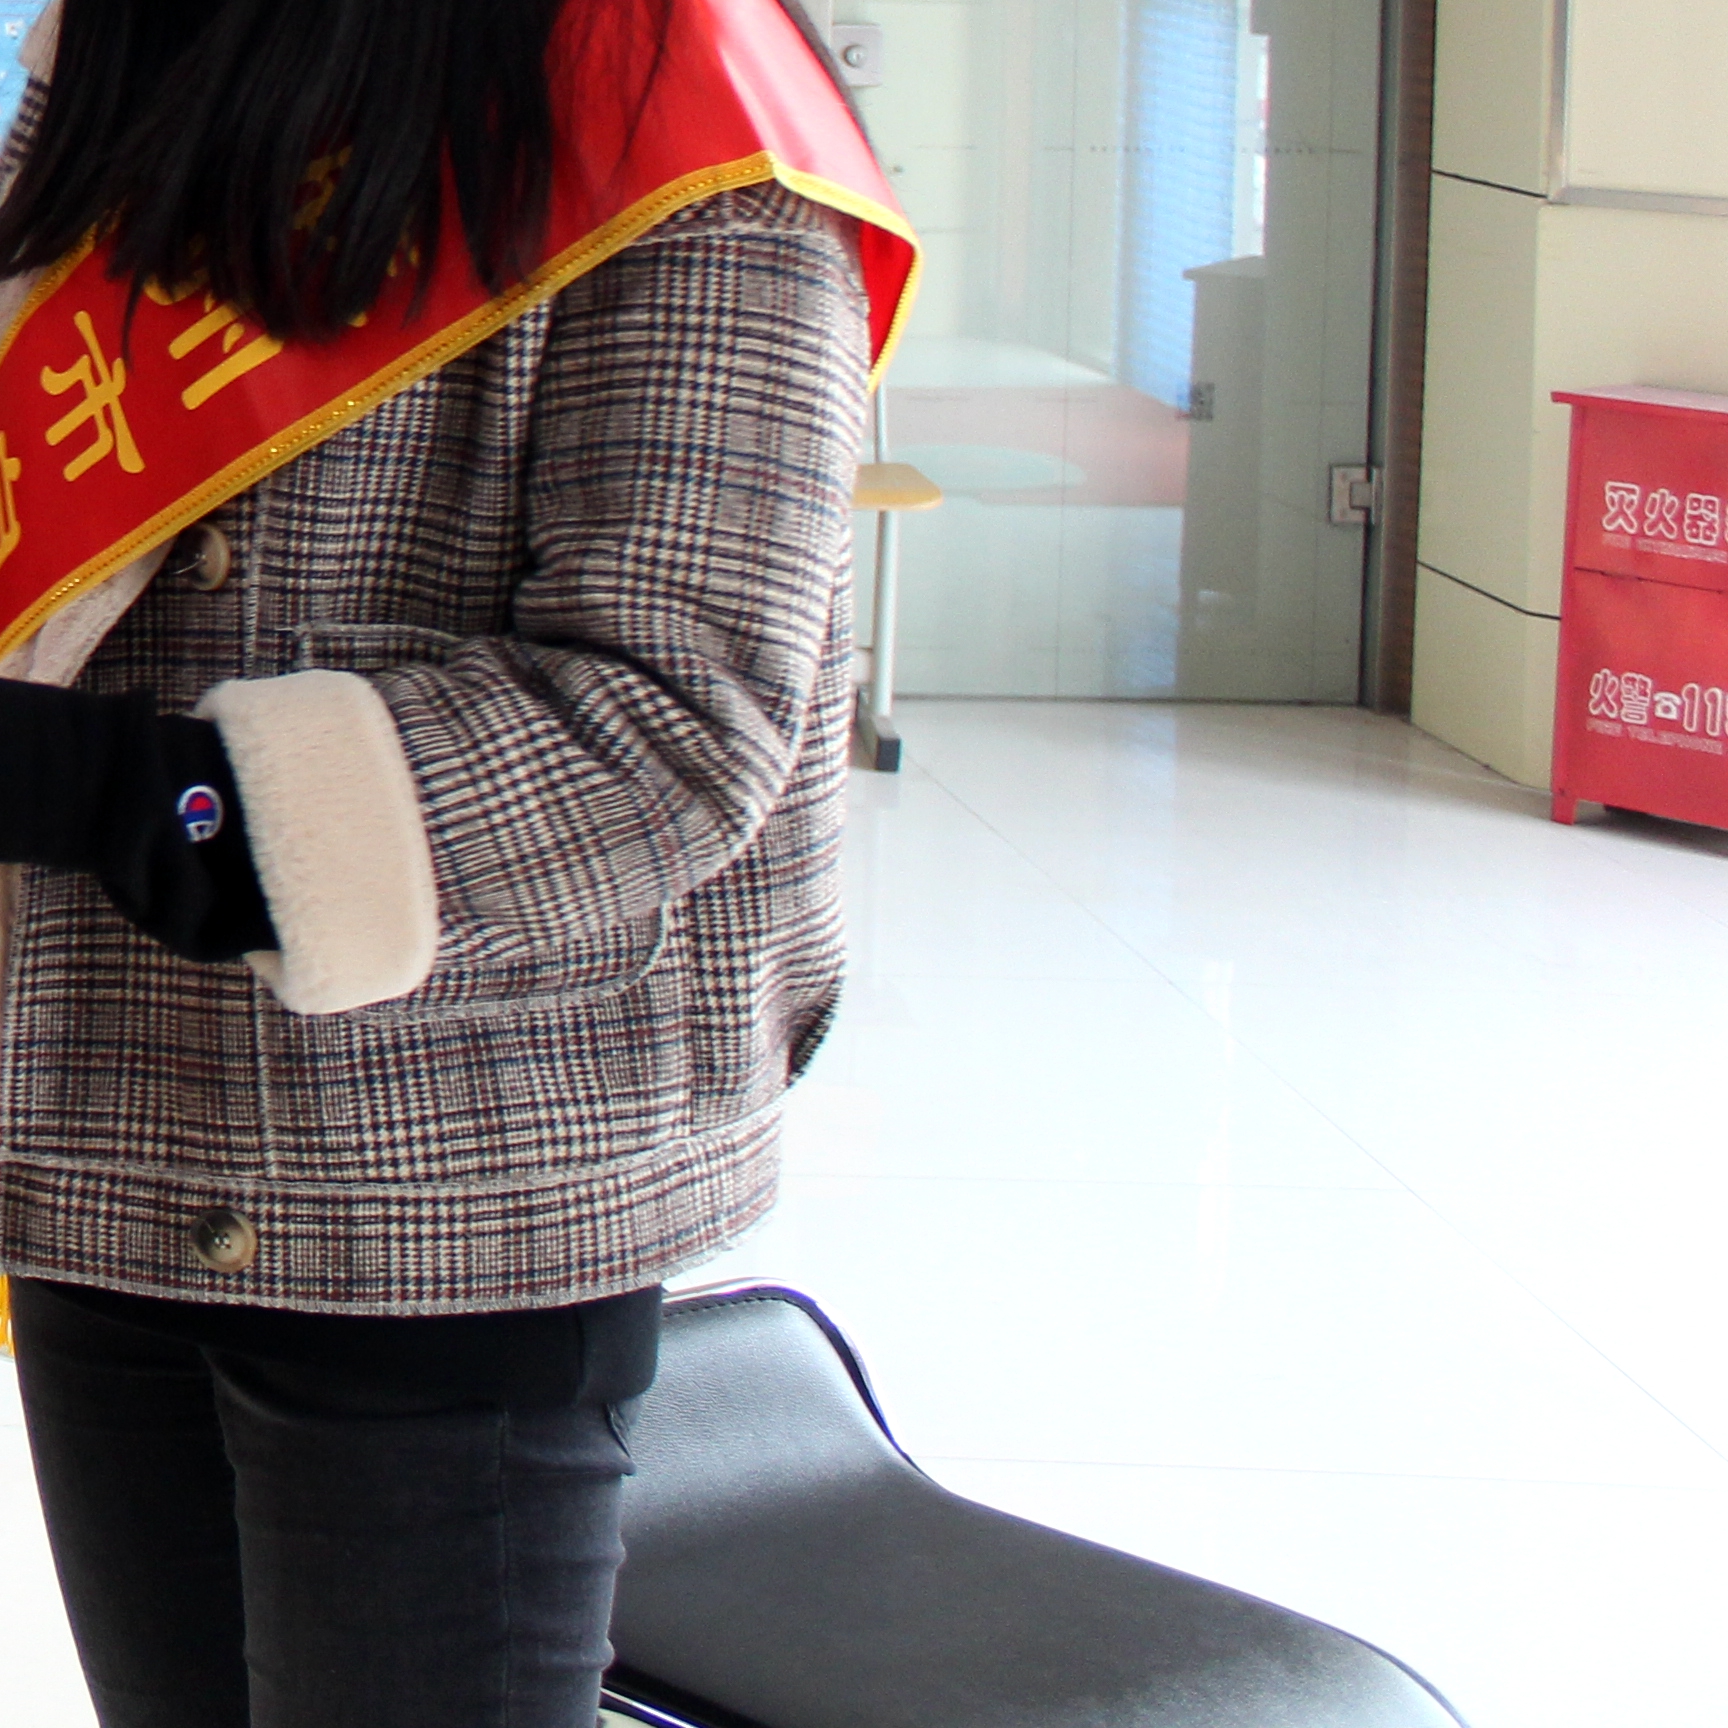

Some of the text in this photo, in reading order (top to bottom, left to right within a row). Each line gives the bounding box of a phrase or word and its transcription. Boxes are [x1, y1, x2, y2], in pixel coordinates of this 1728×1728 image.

[1601, 480, 1720, 547] 灭火器
[1587, 668, 1728, 739] 火警 11
